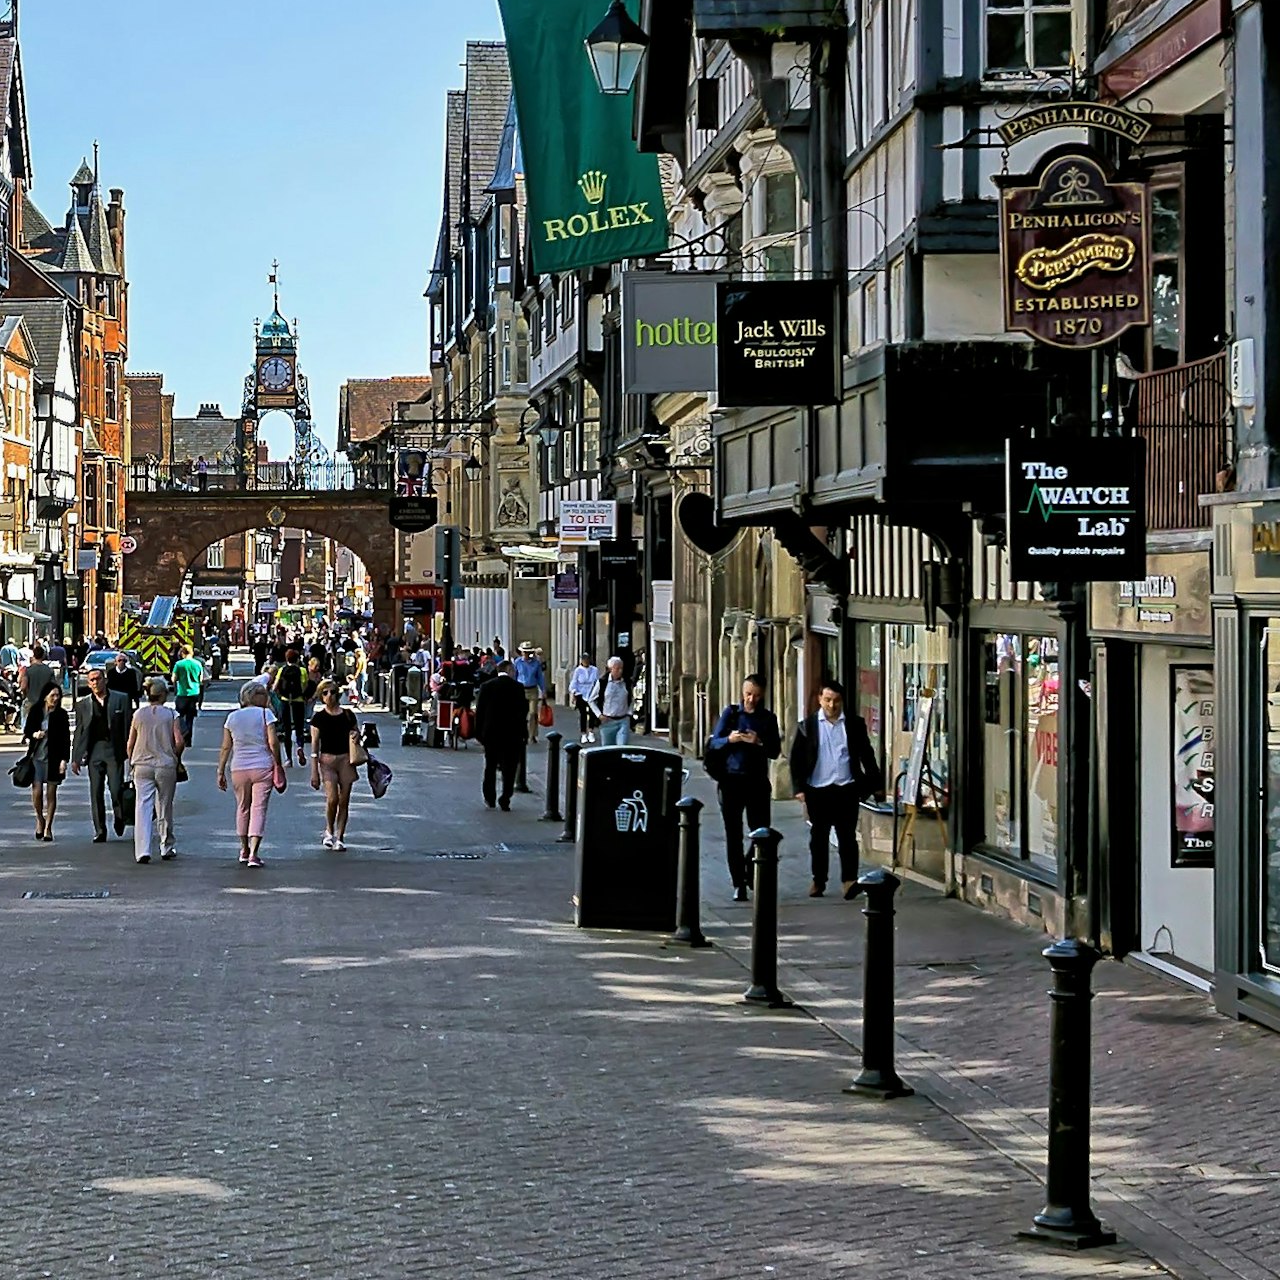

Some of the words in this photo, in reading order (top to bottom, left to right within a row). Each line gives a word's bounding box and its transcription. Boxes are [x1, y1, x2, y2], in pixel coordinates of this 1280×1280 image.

[1004, 107, 1145, 139] PENHALIGON'S
[543, 202, 653, 241] ROLEX
[1008, 211, 1143, 229] PENHALIGON'S
[1029, 243, 1125, 277] PERFUMERS
[1015, 294, 1139, 312] ESTABLISHED
[734, 320, 774, 344] Jack
[779, 319, 826, 337] Wills
[1054, 318, 1103, 336] 1870
[754, 358, 805, 368] BRITISH
[1021, 462, 1068, 480] The
[1039, 487, 1130, 505] WATCH
[569, 515, 585, 523] TO
[588, 515, 606, 523] LET
[1028, 547, 1061, 556] Quality
[1062, 547, 1091, 555] watch
[1092, 547, 1125, 556] repairs
[1184, 836, 1213, 848] The
